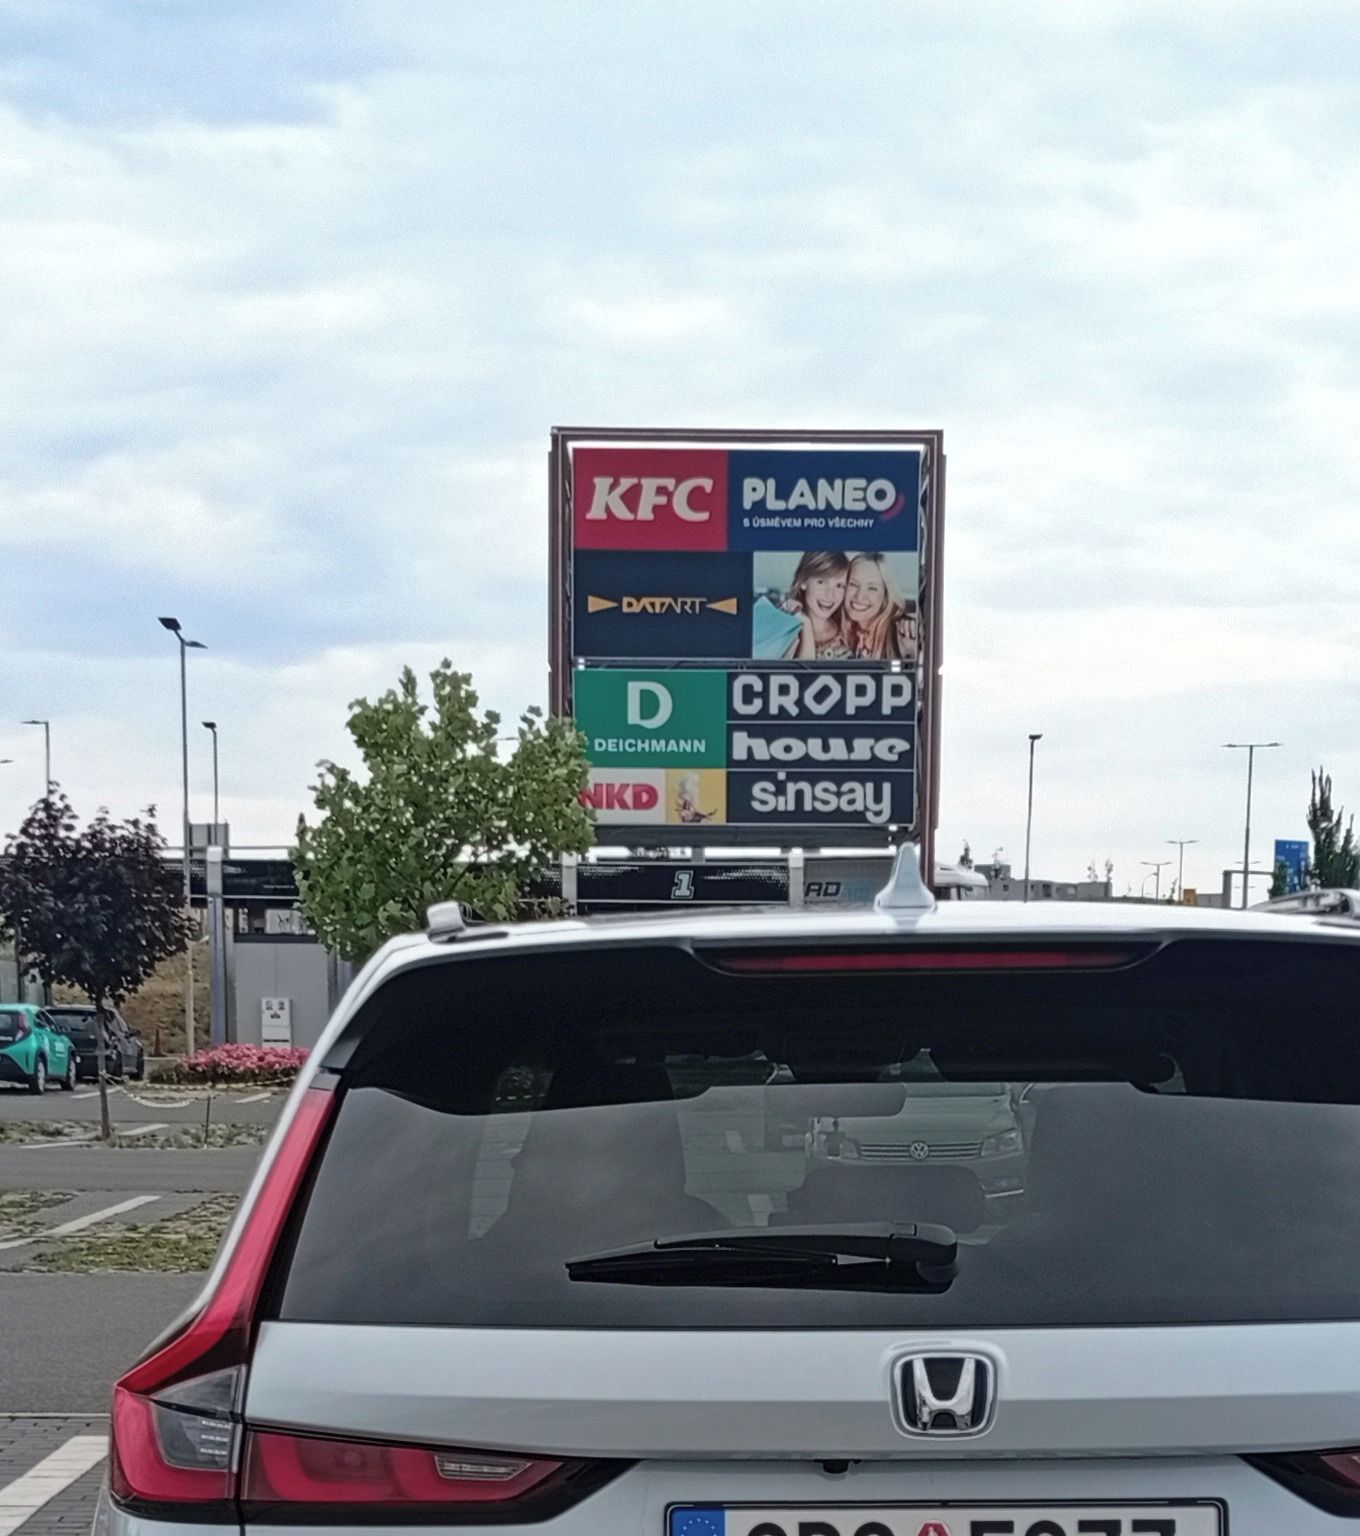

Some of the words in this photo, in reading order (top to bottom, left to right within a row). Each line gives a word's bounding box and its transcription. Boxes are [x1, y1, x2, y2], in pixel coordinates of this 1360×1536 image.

[585, 477, 714, 522] KFC
[743, 477, 897, 512] PLANEO
[804, 518, 826, 528] PRO
[828, 516, 875, 528] VŠECHNY
[622, 597, 707, 615] DATART
[732, 675, 912, 717] CROPP
[594, 738, 706, 753] DEICHMANN
[732, 731, 911, 762] house
[578, 783, 659, 811] NKD
[750, 772, 892, 824] sinsay
